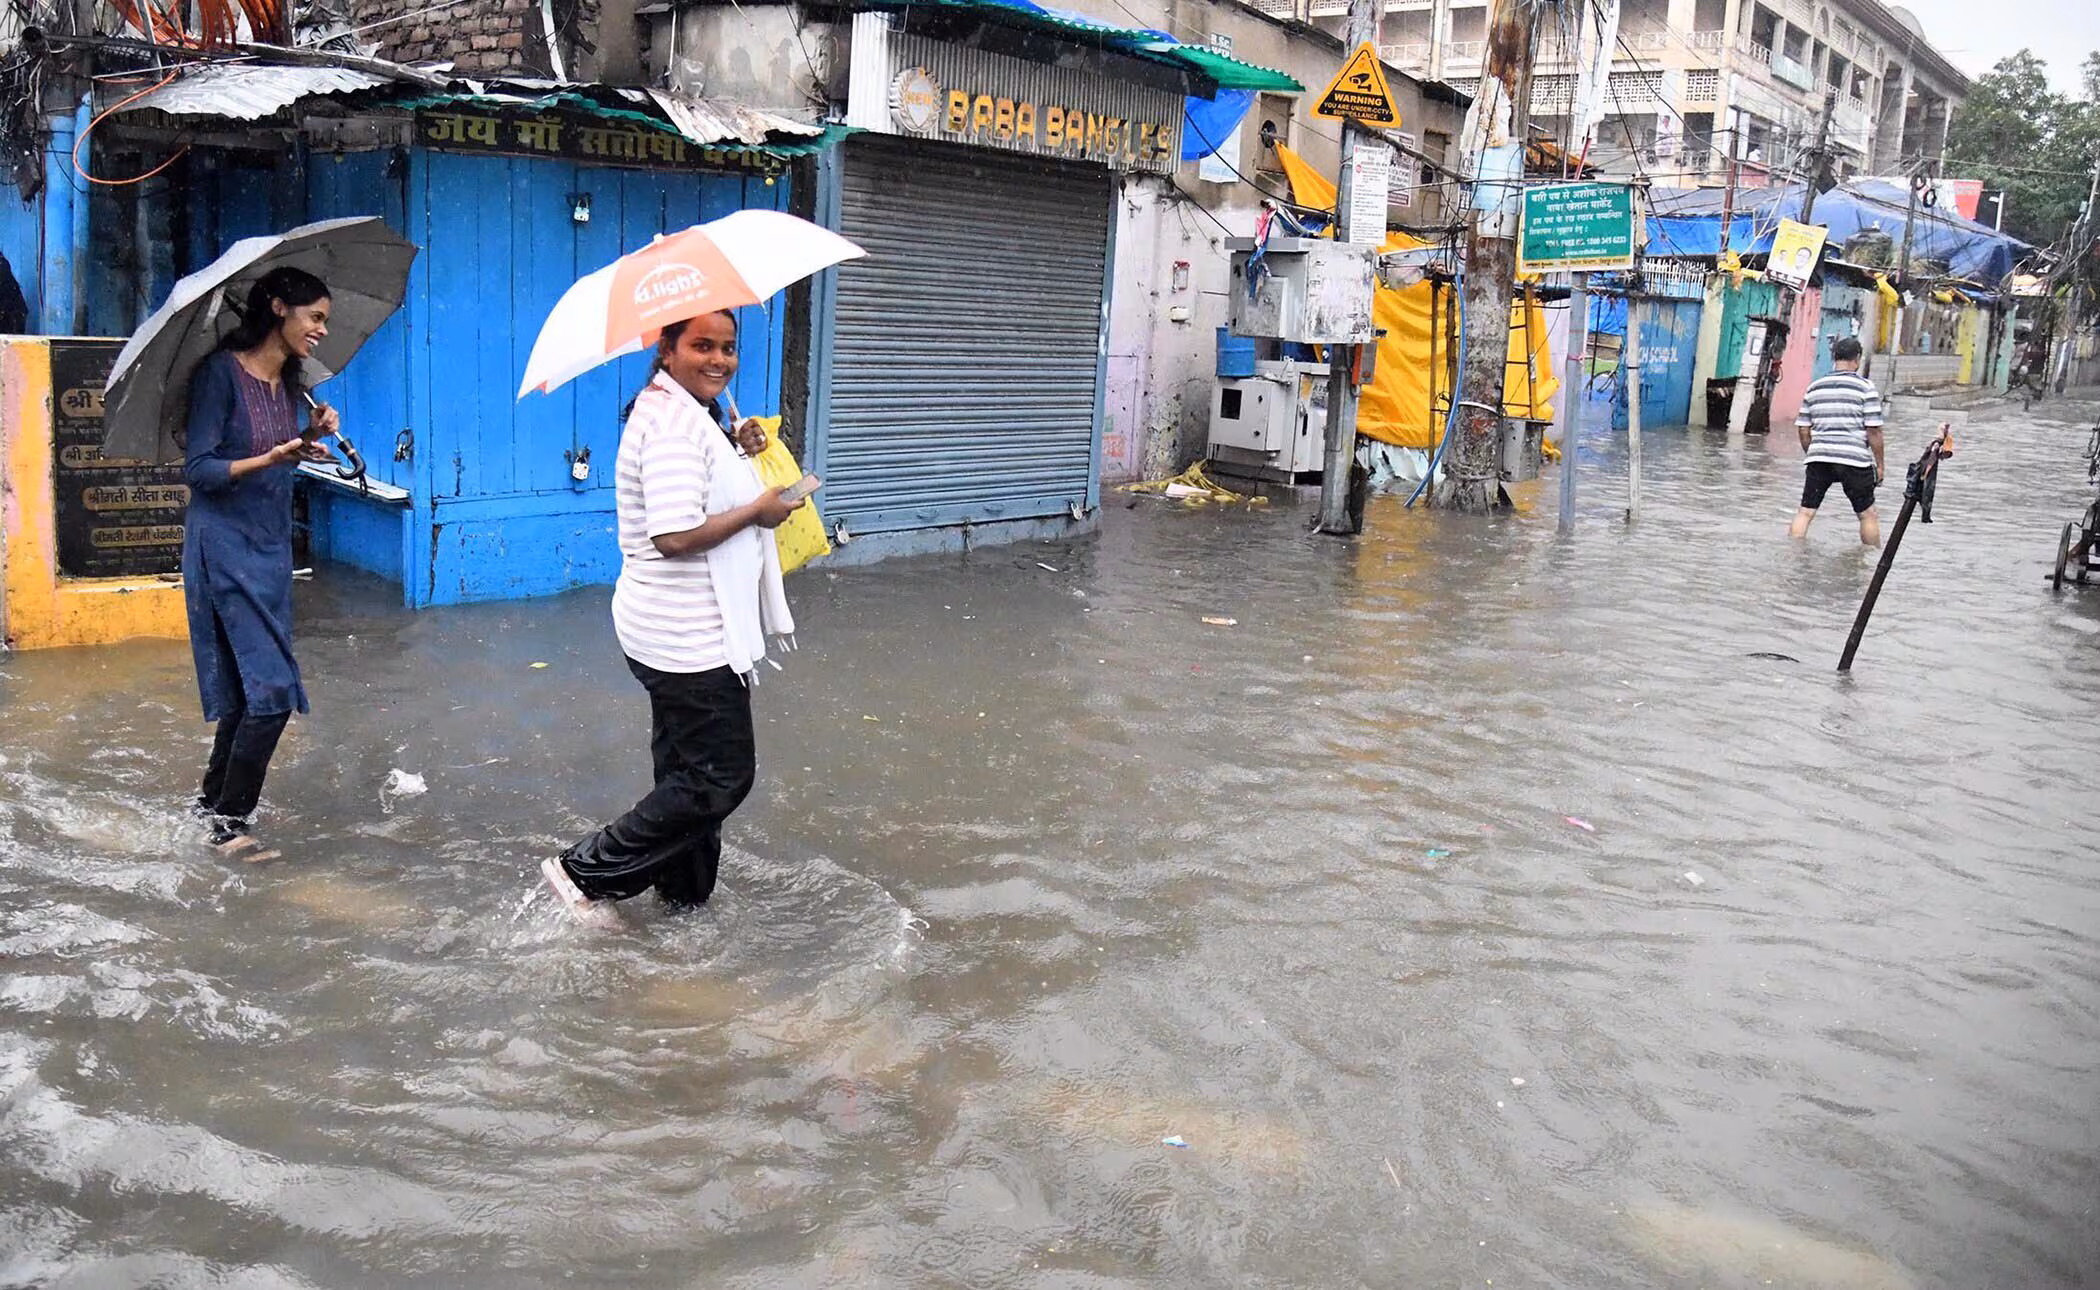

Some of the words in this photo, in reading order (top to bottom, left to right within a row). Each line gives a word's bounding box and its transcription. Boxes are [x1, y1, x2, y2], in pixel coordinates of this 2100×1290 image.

[1324, 102, 1337, 110] YOU
[1334, 93, 1382, 106] WARNING
[424, 112, 502, 145] जय
[949, 89, 1036, 152] BABA
[1046, 105, 1173, 163] BANGLES
[1549, 191, 1560, 200] पथ
[1562, 189, 1570, 199] से
[1573, 187, 1597, 199] अशोक
[1599, 186, 1625, 196] राजपथ
[1566, 200, 1588, 211] खेतान
[1556, 213, 1562, 222] के
[1560, 239, 1576, 247] FREE
[635, 272, 701, 304] d.light
[67, 390, 92, 409] श्री
[65, 447, 82, 462] श्री
[88, 487, 127, 504] श्रीमती
[131, 487, 159, 503] सीता
